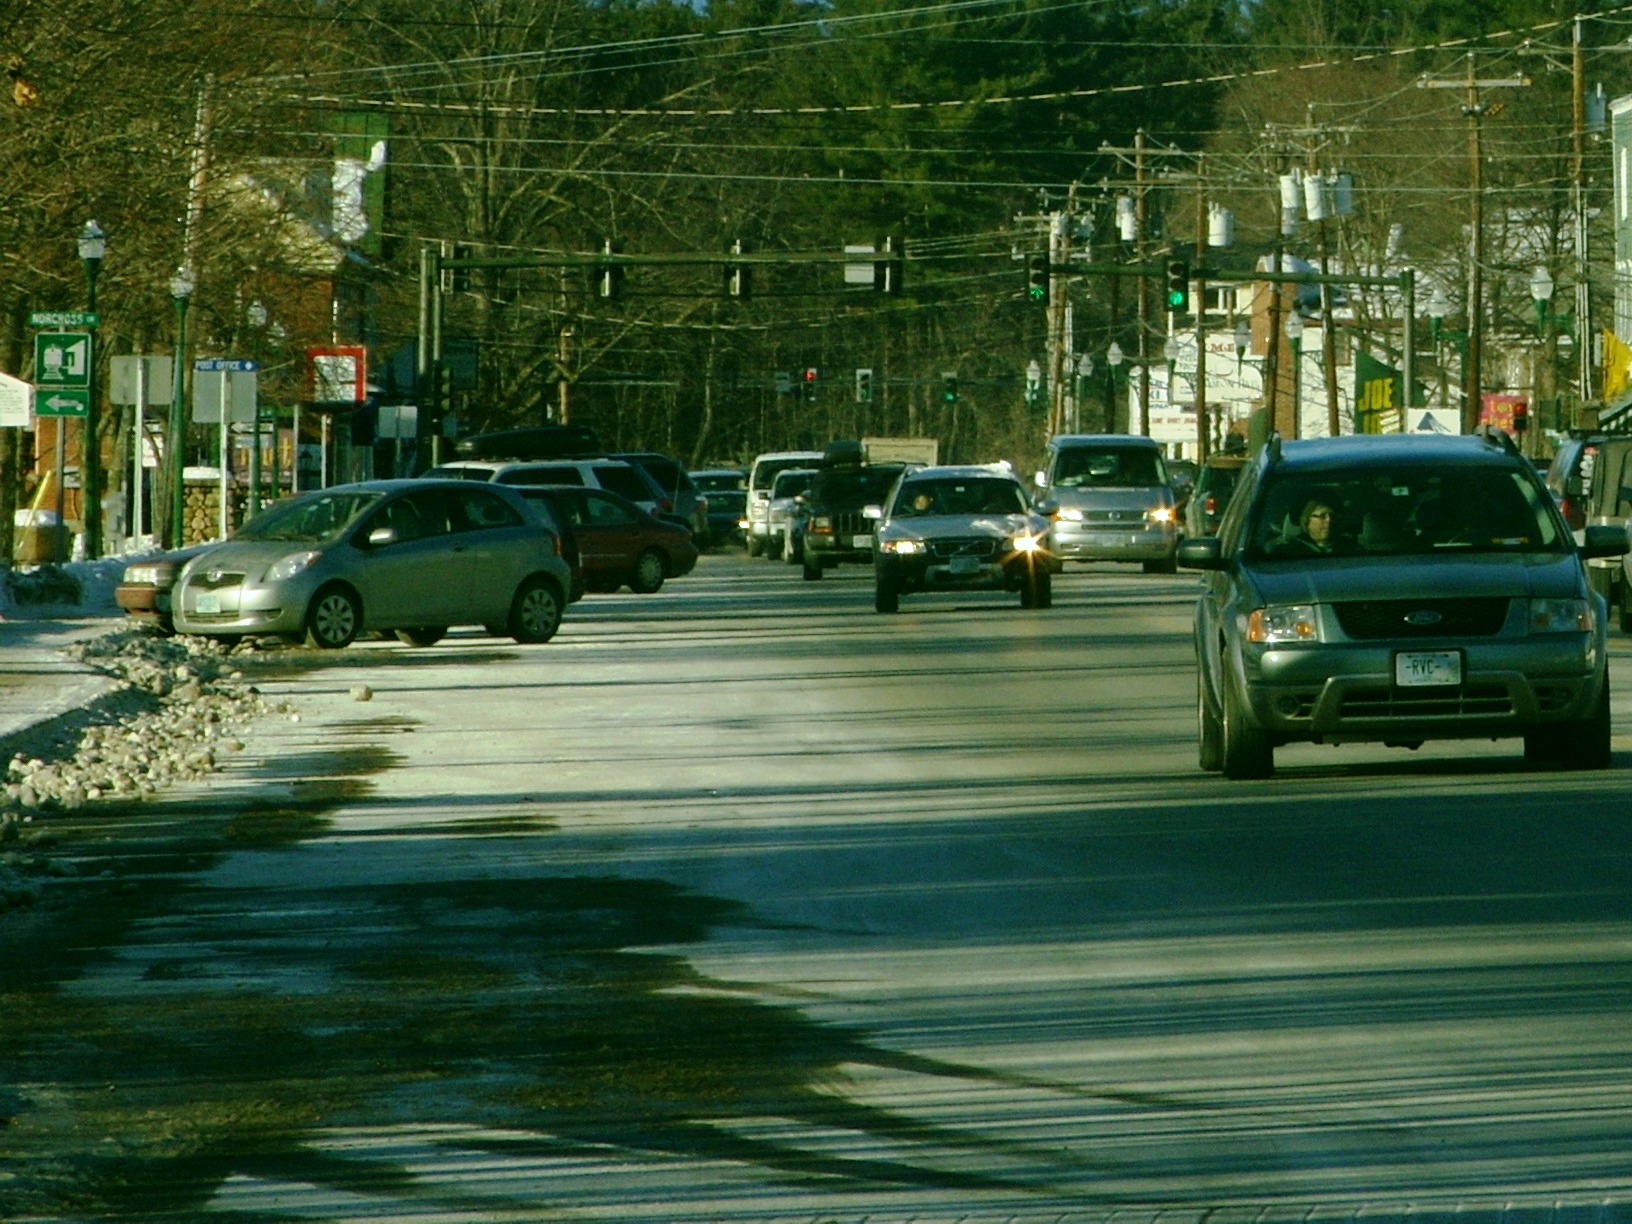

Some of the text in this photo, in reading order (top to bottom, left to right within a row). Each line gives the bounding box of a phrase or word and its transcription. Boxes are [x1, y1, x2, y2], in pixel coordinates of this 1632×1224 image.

[194, 361, 240, 370] POST OFFICE
[1358, 377, 1394, 411] JOE
